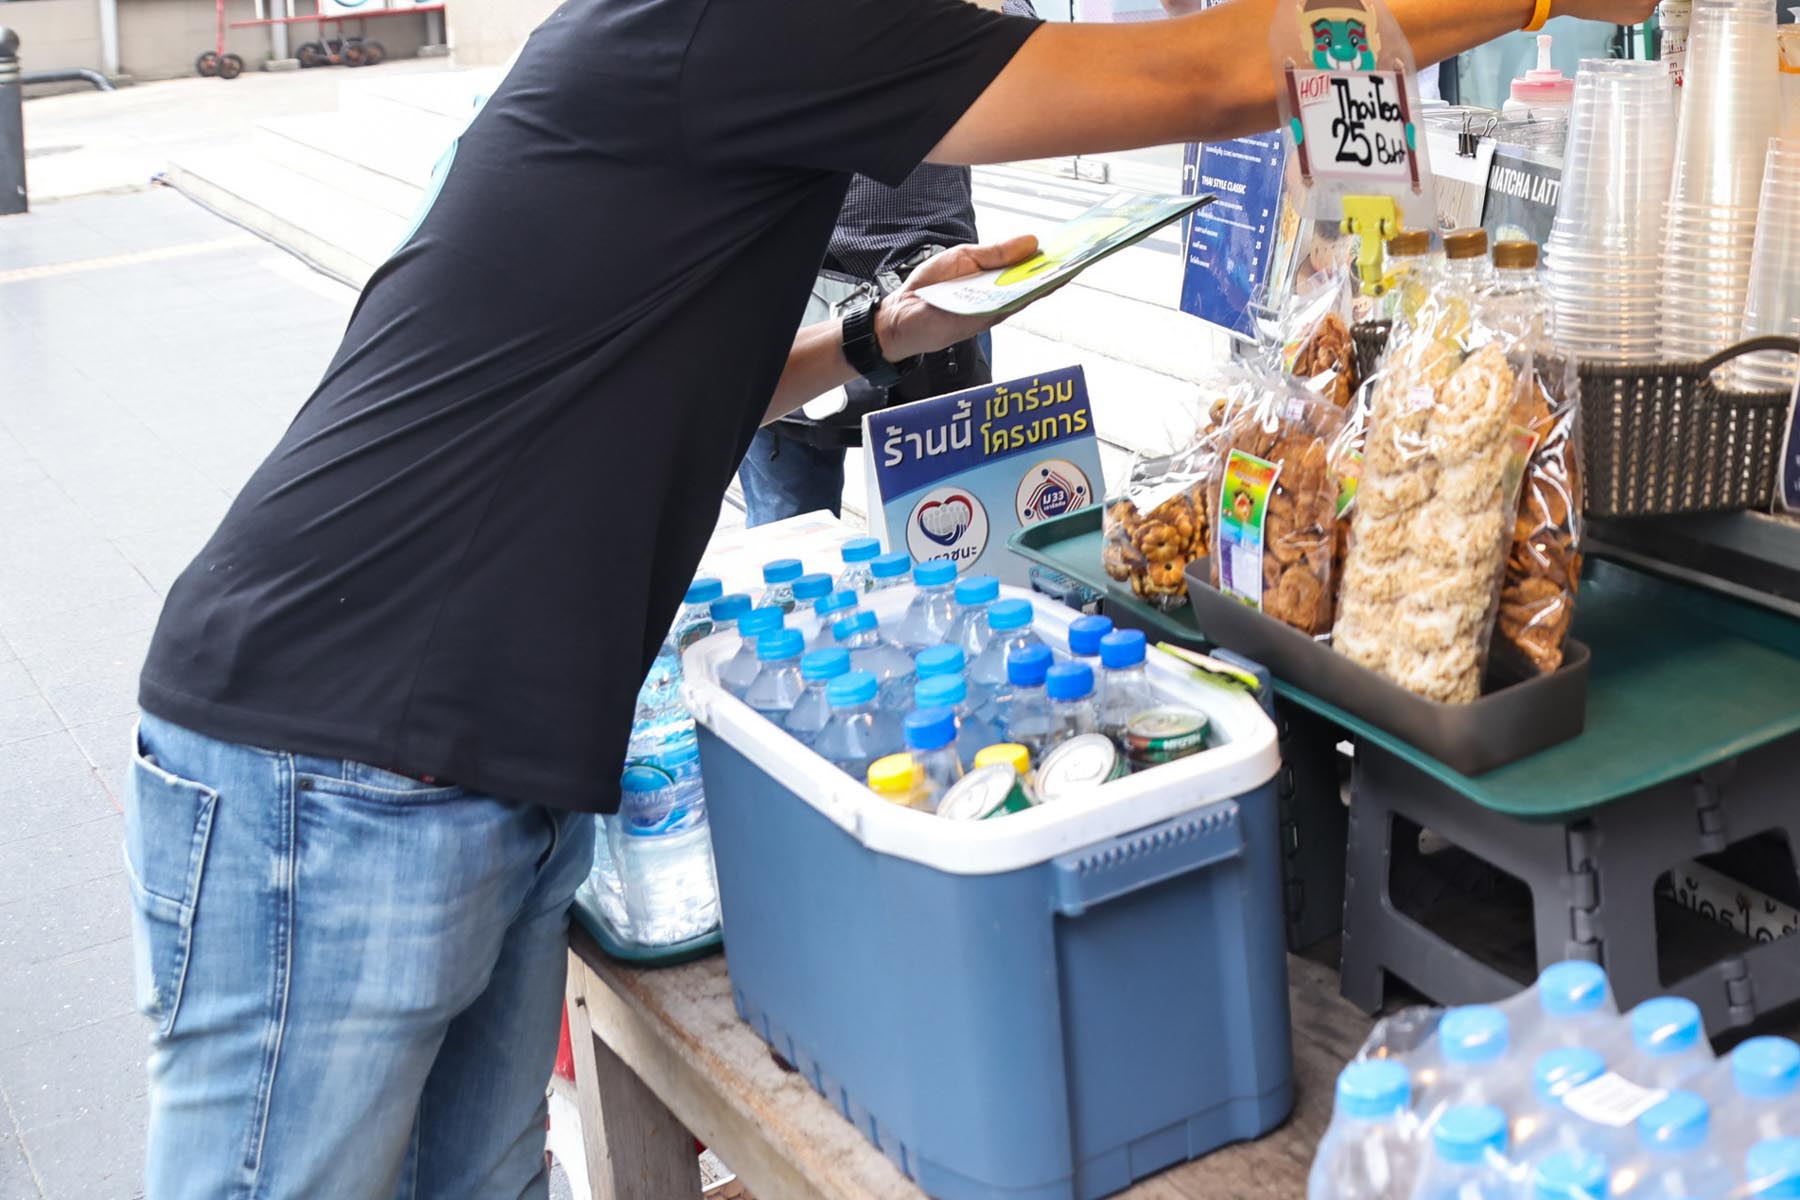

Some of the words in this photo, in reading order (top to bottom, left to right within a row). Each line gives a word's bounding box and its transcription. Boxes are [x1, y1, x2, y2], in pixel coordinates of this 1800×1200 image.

[1300, 75, 1331, 101] HOT!
[1332, 118, 1373, 167] 25
[1213, 177, 1227, 191] STYLE
[1227, 180, 1247, 195] CLASSIC
[1491, 165, 1529, 200] MATCHA
[884, 399, 973, 468] ร้านนี้
[985, 378, 1074, 421] เข้าร่วม
[979, 408, 1089, 455] โครงการ
